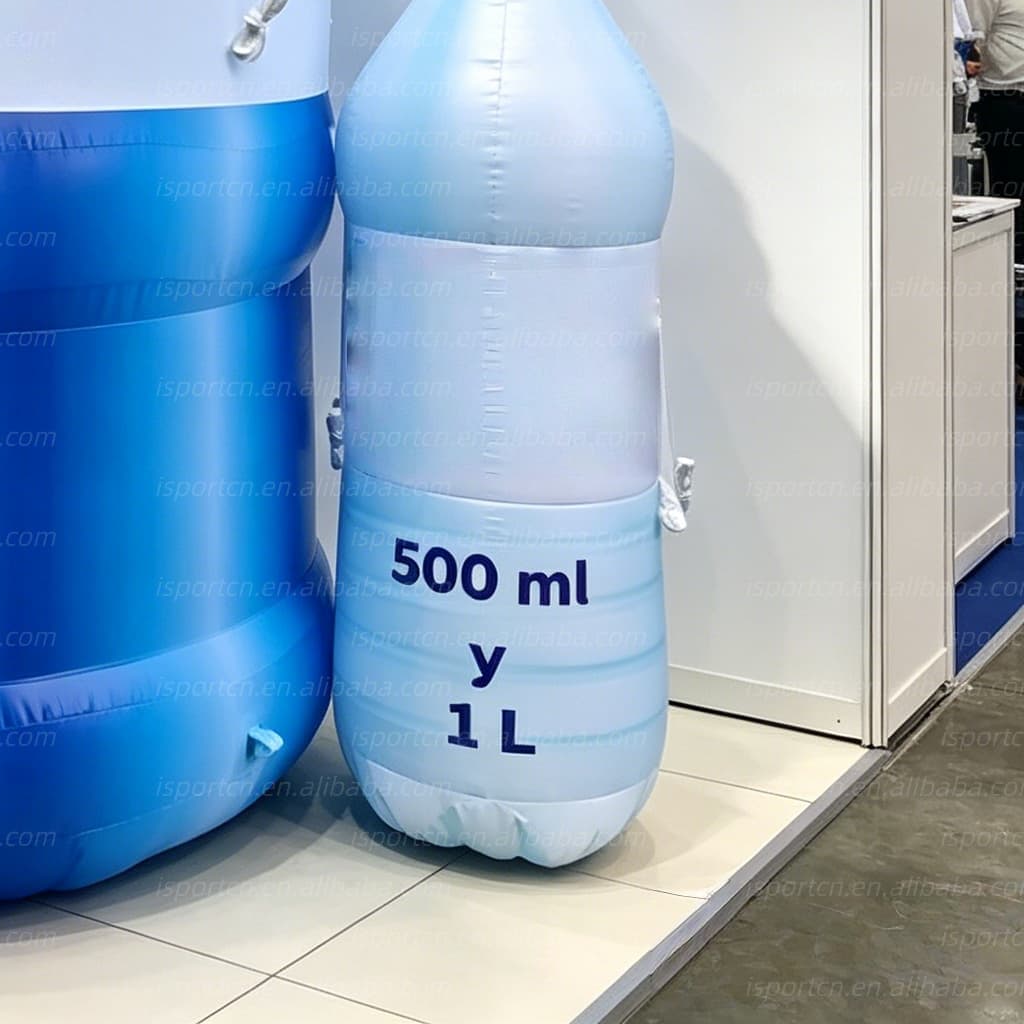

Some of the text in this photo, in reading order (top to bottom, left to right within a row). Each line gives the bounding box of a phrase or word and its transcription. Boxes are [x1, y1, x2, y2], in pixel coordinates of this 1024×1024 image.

[391, 537, 589, 606] 500 ml
[468, 642, 507, 688] y
[447, 703, 536, 755] 1 L
